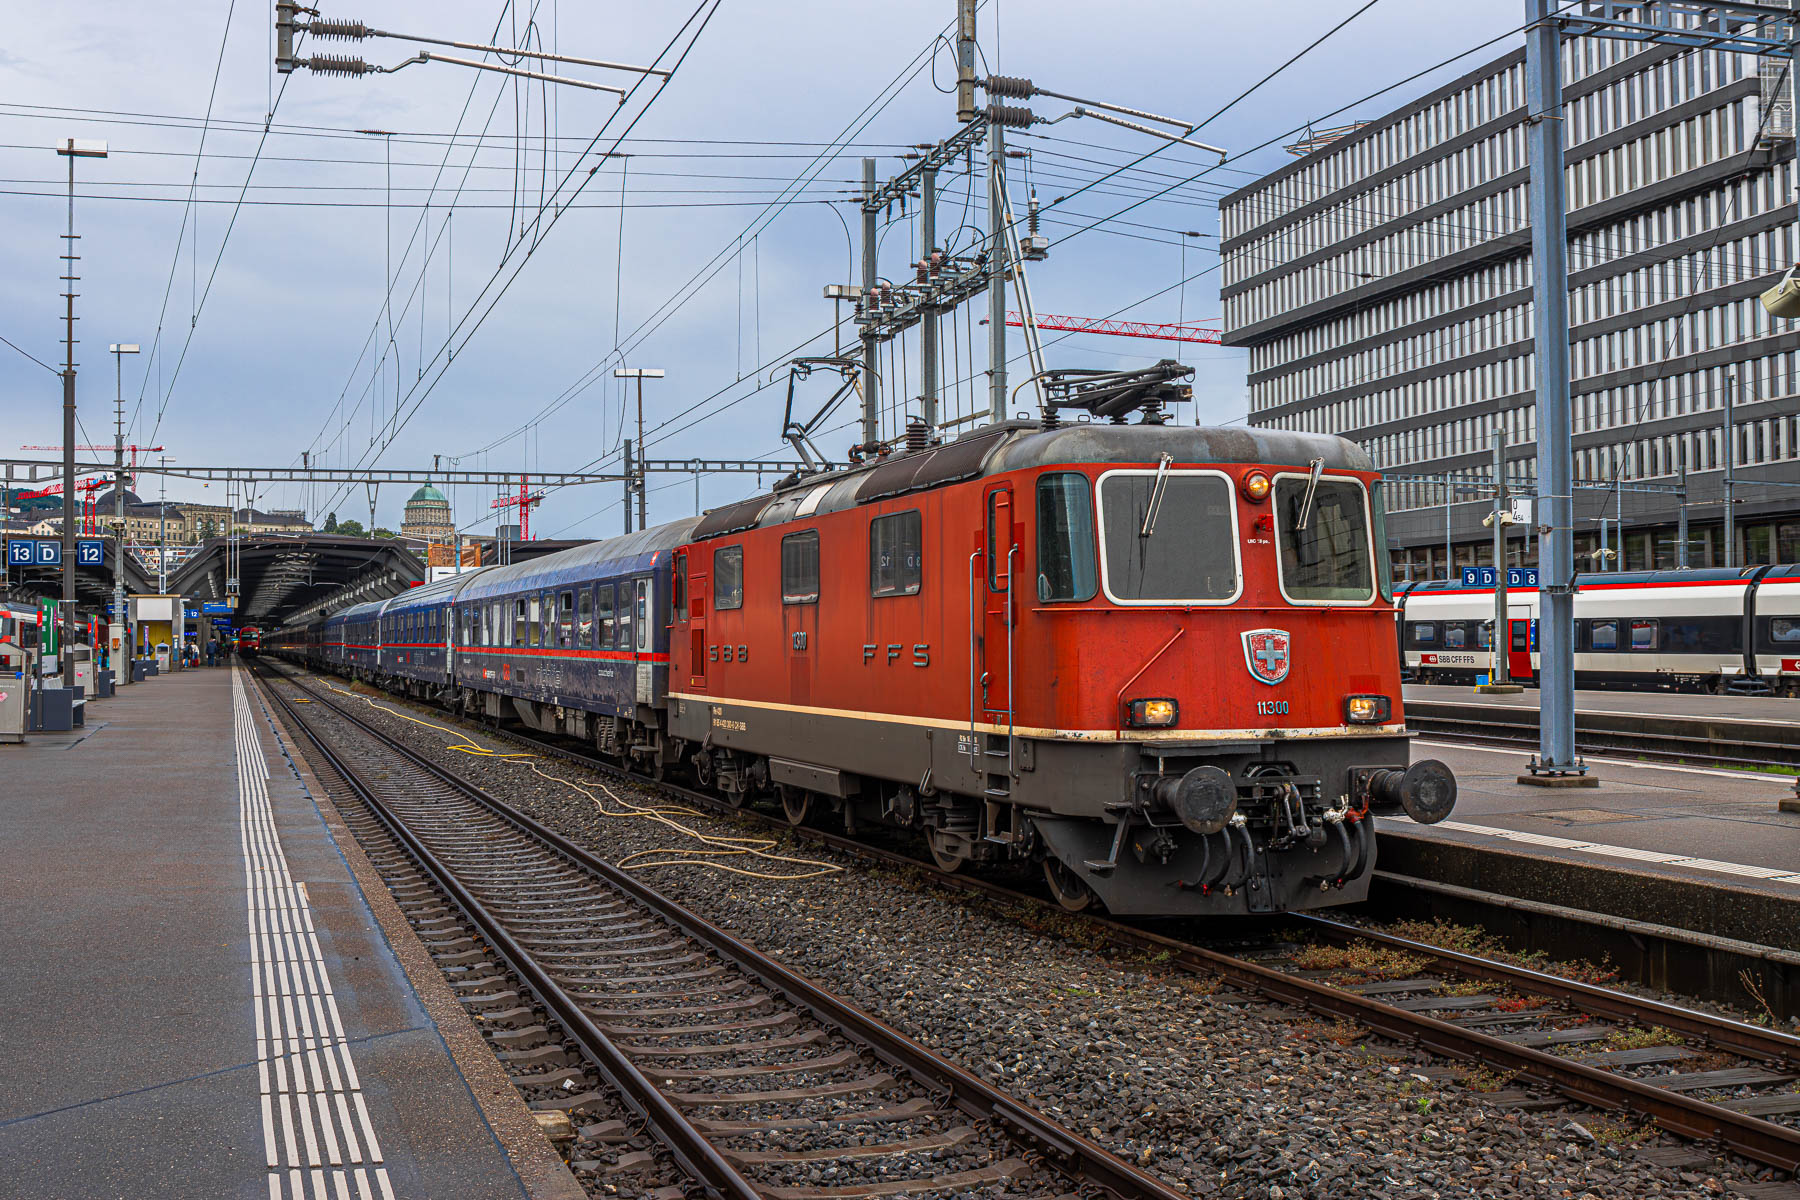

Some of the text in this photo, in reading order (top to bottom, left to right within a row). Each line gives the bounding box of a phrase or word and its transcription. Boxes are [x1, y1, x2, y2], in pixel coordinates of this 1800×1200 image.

[13, 548, 30, 561] 13
[42, 548, 55, 561] D
[82, 548, 99, 561] 12
[1467, 573, 1475, 584] 9
[1484, 573, 1492, 584] D
[1512, 573, 1520, 584] D
[1528, 574, 1536, 585] 8
[1438, 655, 1475, 664] SBB CFF FFS
[1256, 700, 1289, 716] 11300
